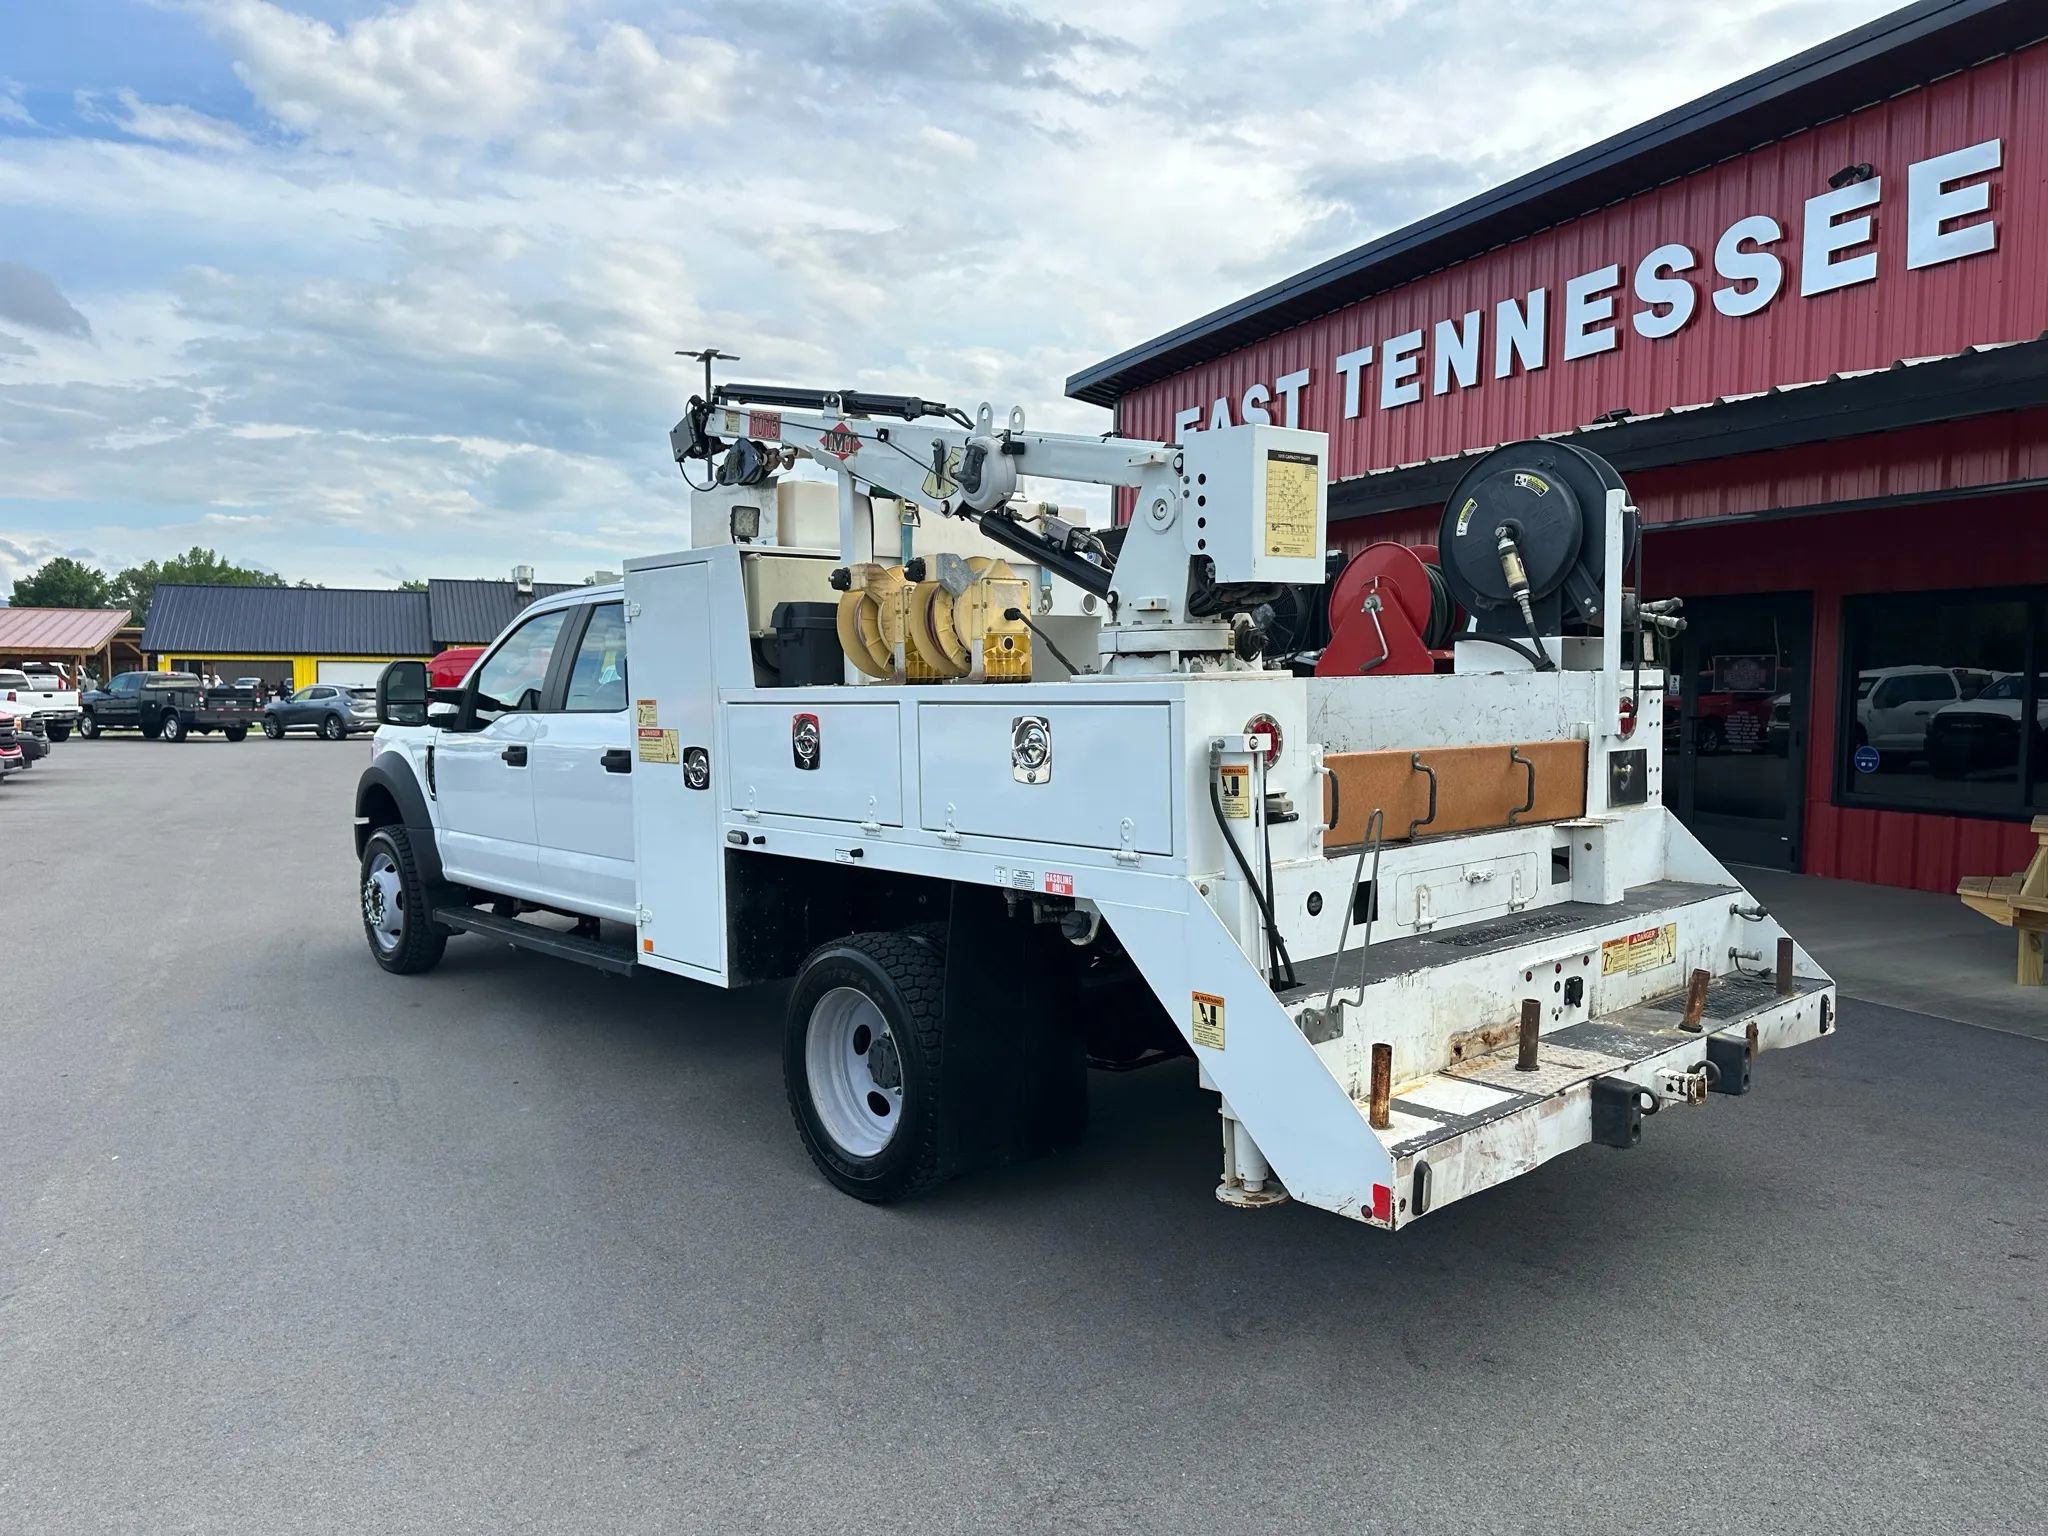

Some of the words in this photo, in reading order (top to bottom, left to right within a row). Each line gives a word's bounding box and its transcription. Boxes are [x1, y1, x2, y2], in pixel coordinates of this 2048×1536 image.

[1175, 368, 1310, 444] EAST
[1336, 138, 2001, 420] TENNESSEE
[824, 430, 858, 456] IMT
[1046, 873, 1073, 885] GASOLINE
[1052, 882, 1066, 893] ONLY
